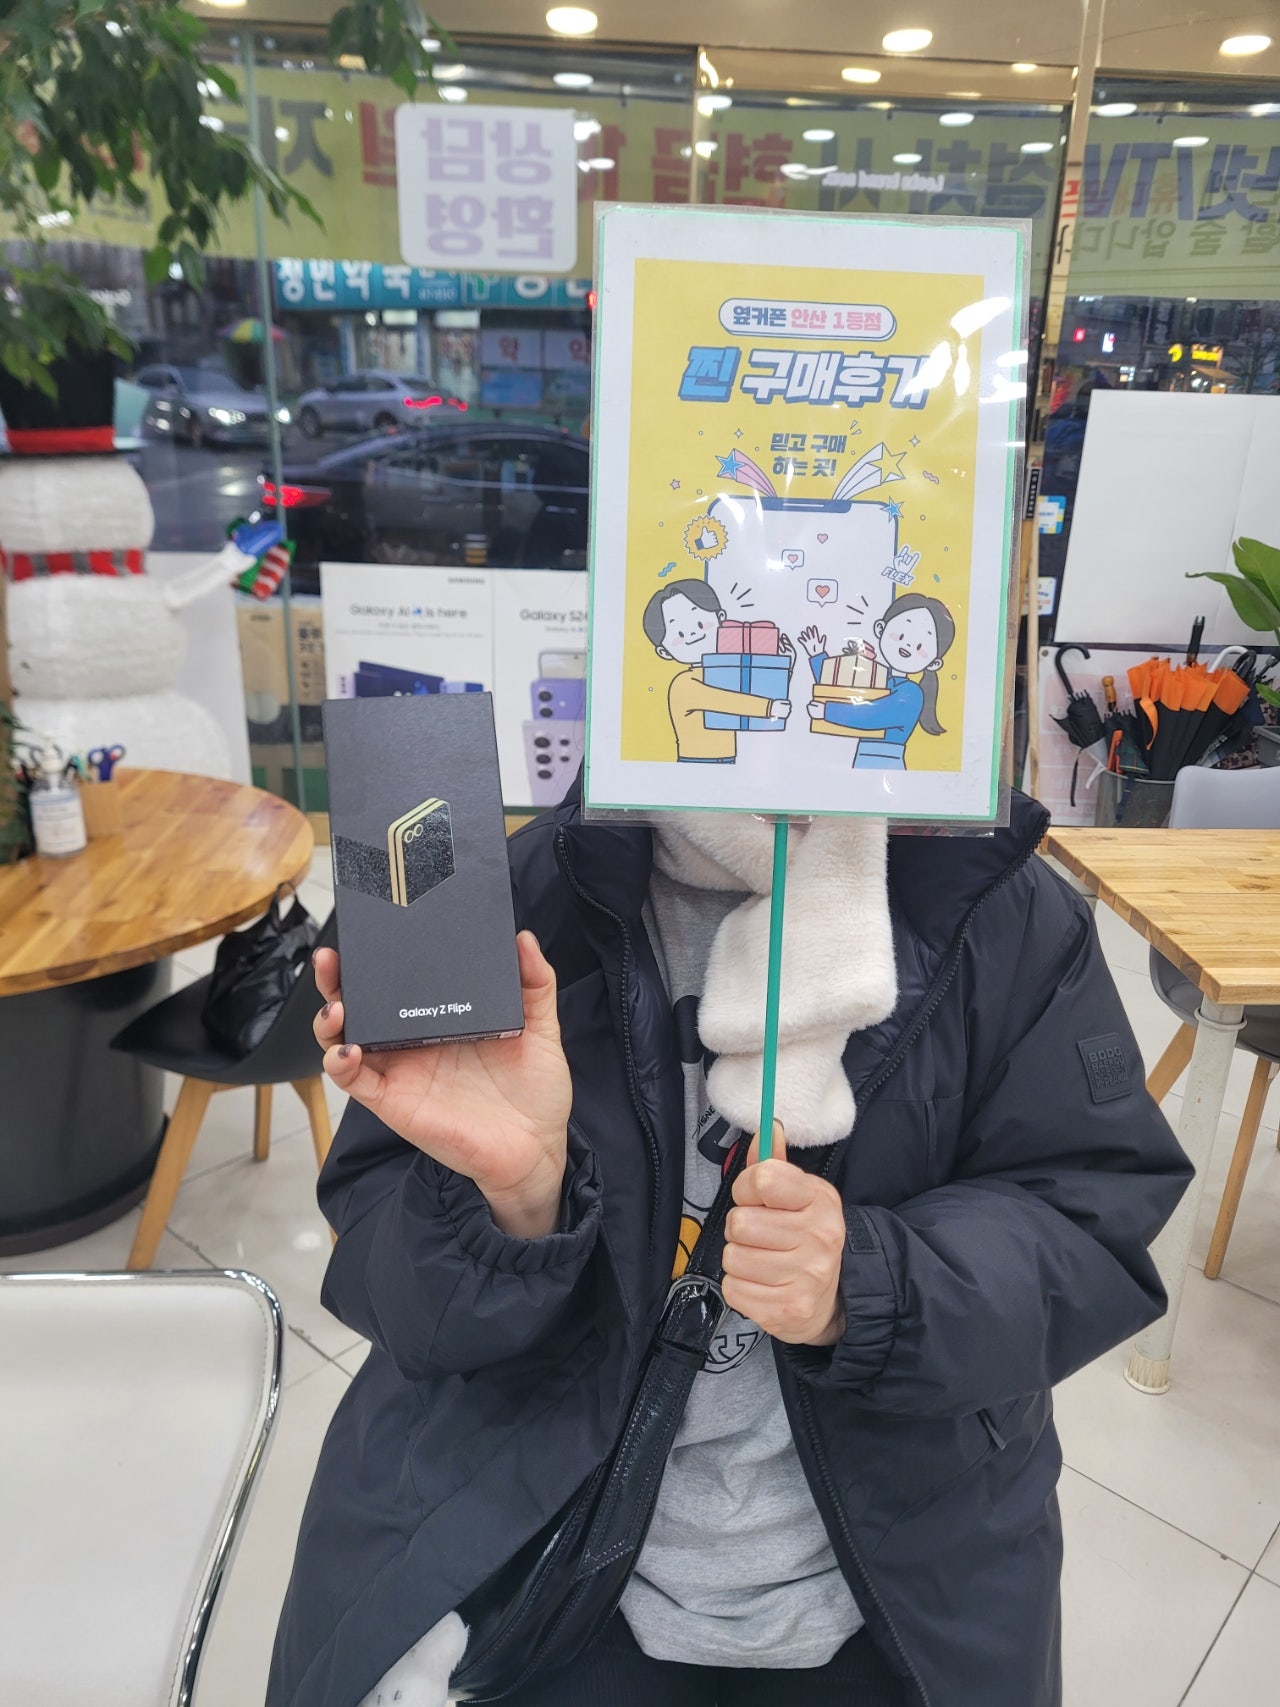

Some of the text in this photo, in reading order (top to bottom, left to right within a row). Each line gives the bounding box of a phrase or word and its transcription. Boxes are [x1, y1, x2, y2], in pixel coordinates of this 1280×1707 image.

[733, 305, 882, 331] 옆커폰 안산 1등점
[679, 346, 932, 410] 찐 구매후기
[770, 432, 847, 453] 믿고 구매
[773, 456, 837, 477] 하는 곳!
[881, 566, 914, 586] FLEX
[520, 608, 567, 624] Galaxy
[399, 1002, 472, 1019] Galaxy Z Flip6
